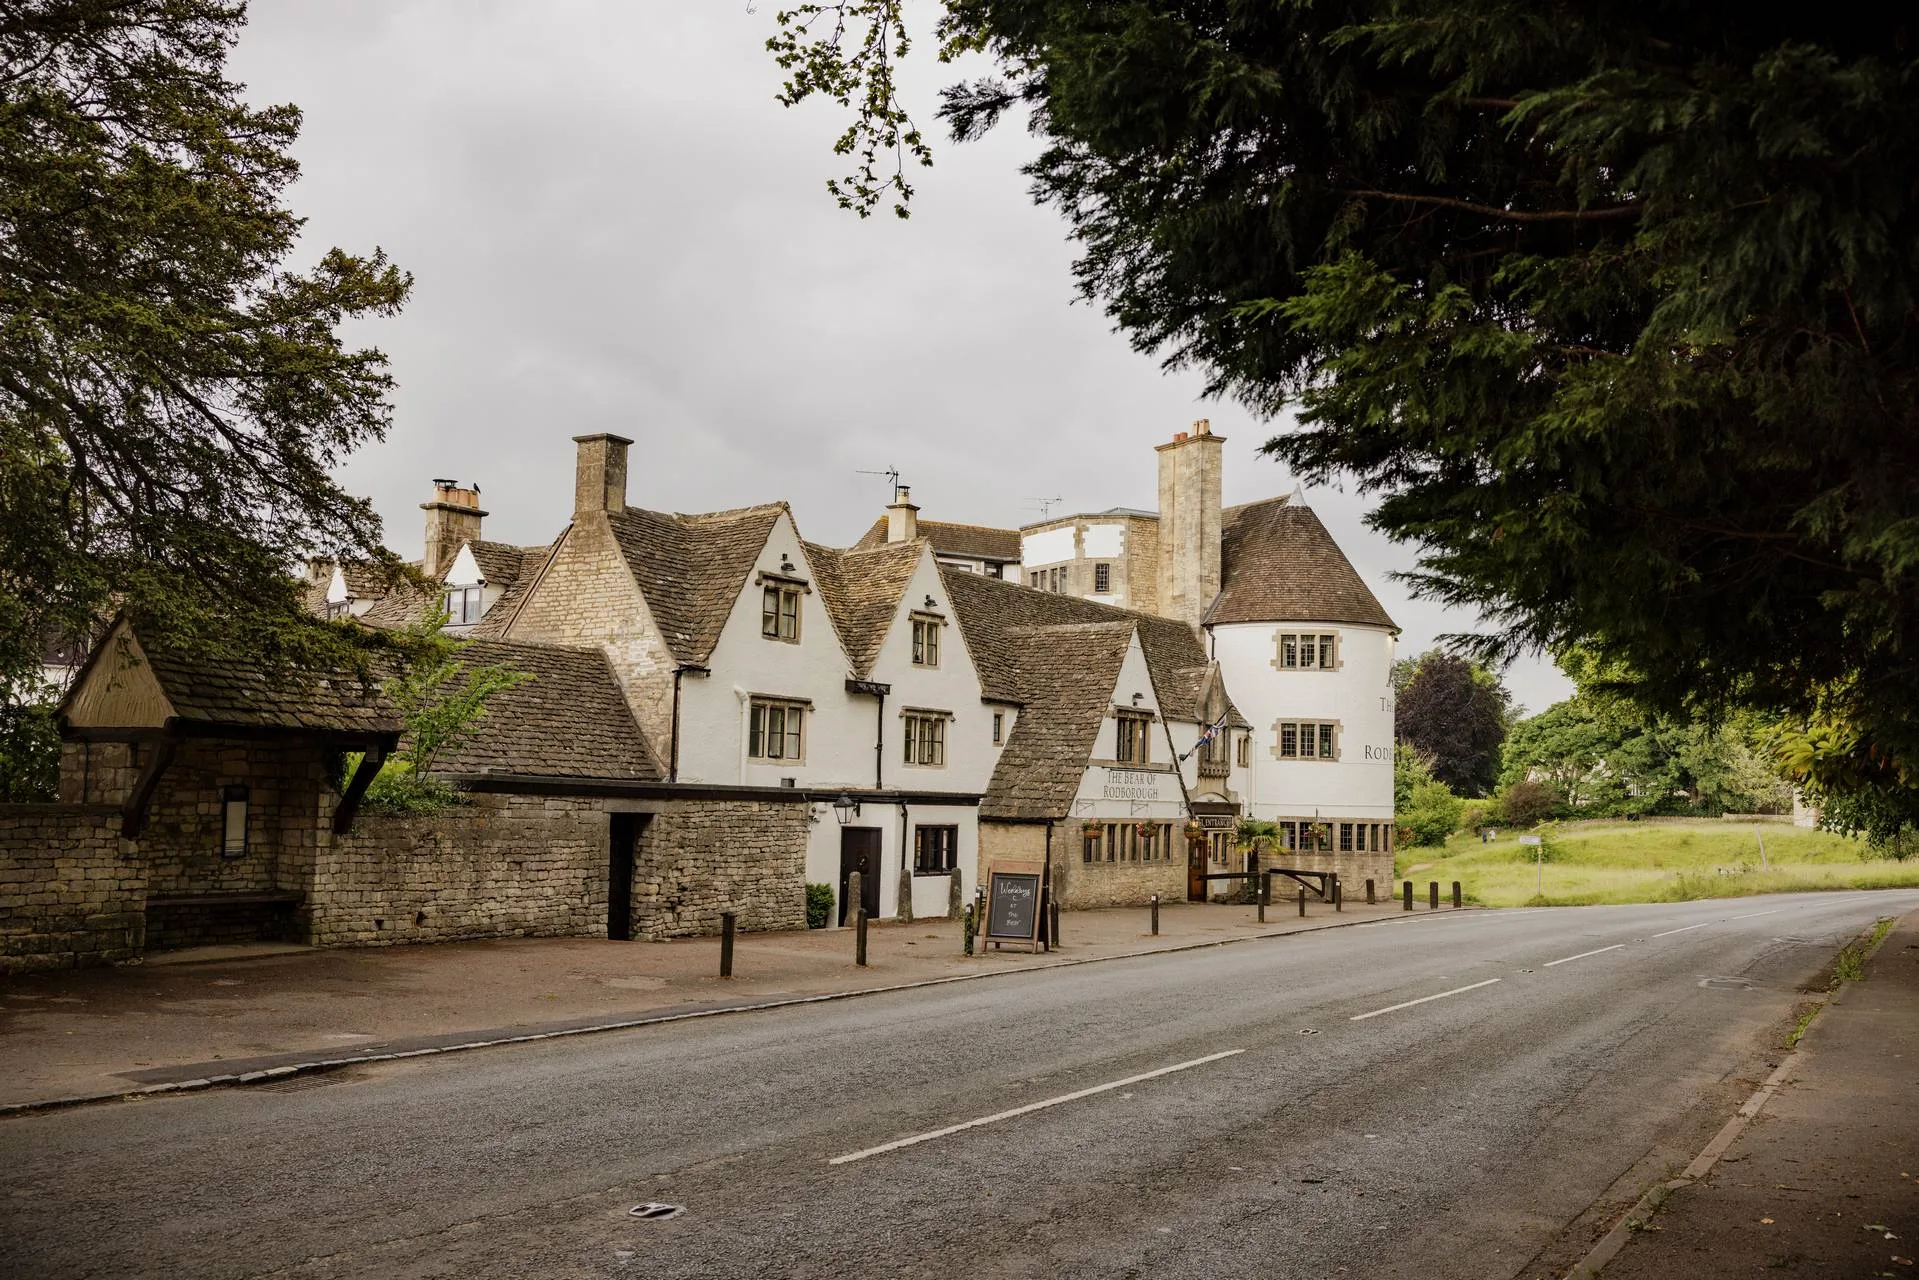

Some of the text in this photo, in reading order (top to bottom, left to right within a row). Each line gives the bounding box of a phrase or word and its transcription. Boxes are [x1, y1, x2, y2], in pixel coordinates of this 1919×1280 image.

[1379, 696, 1394, 713] TH
[1107, 770, 1157, 785] THE BEAR OF
[1103, 786, 1158, 799] RODBOROUGH
